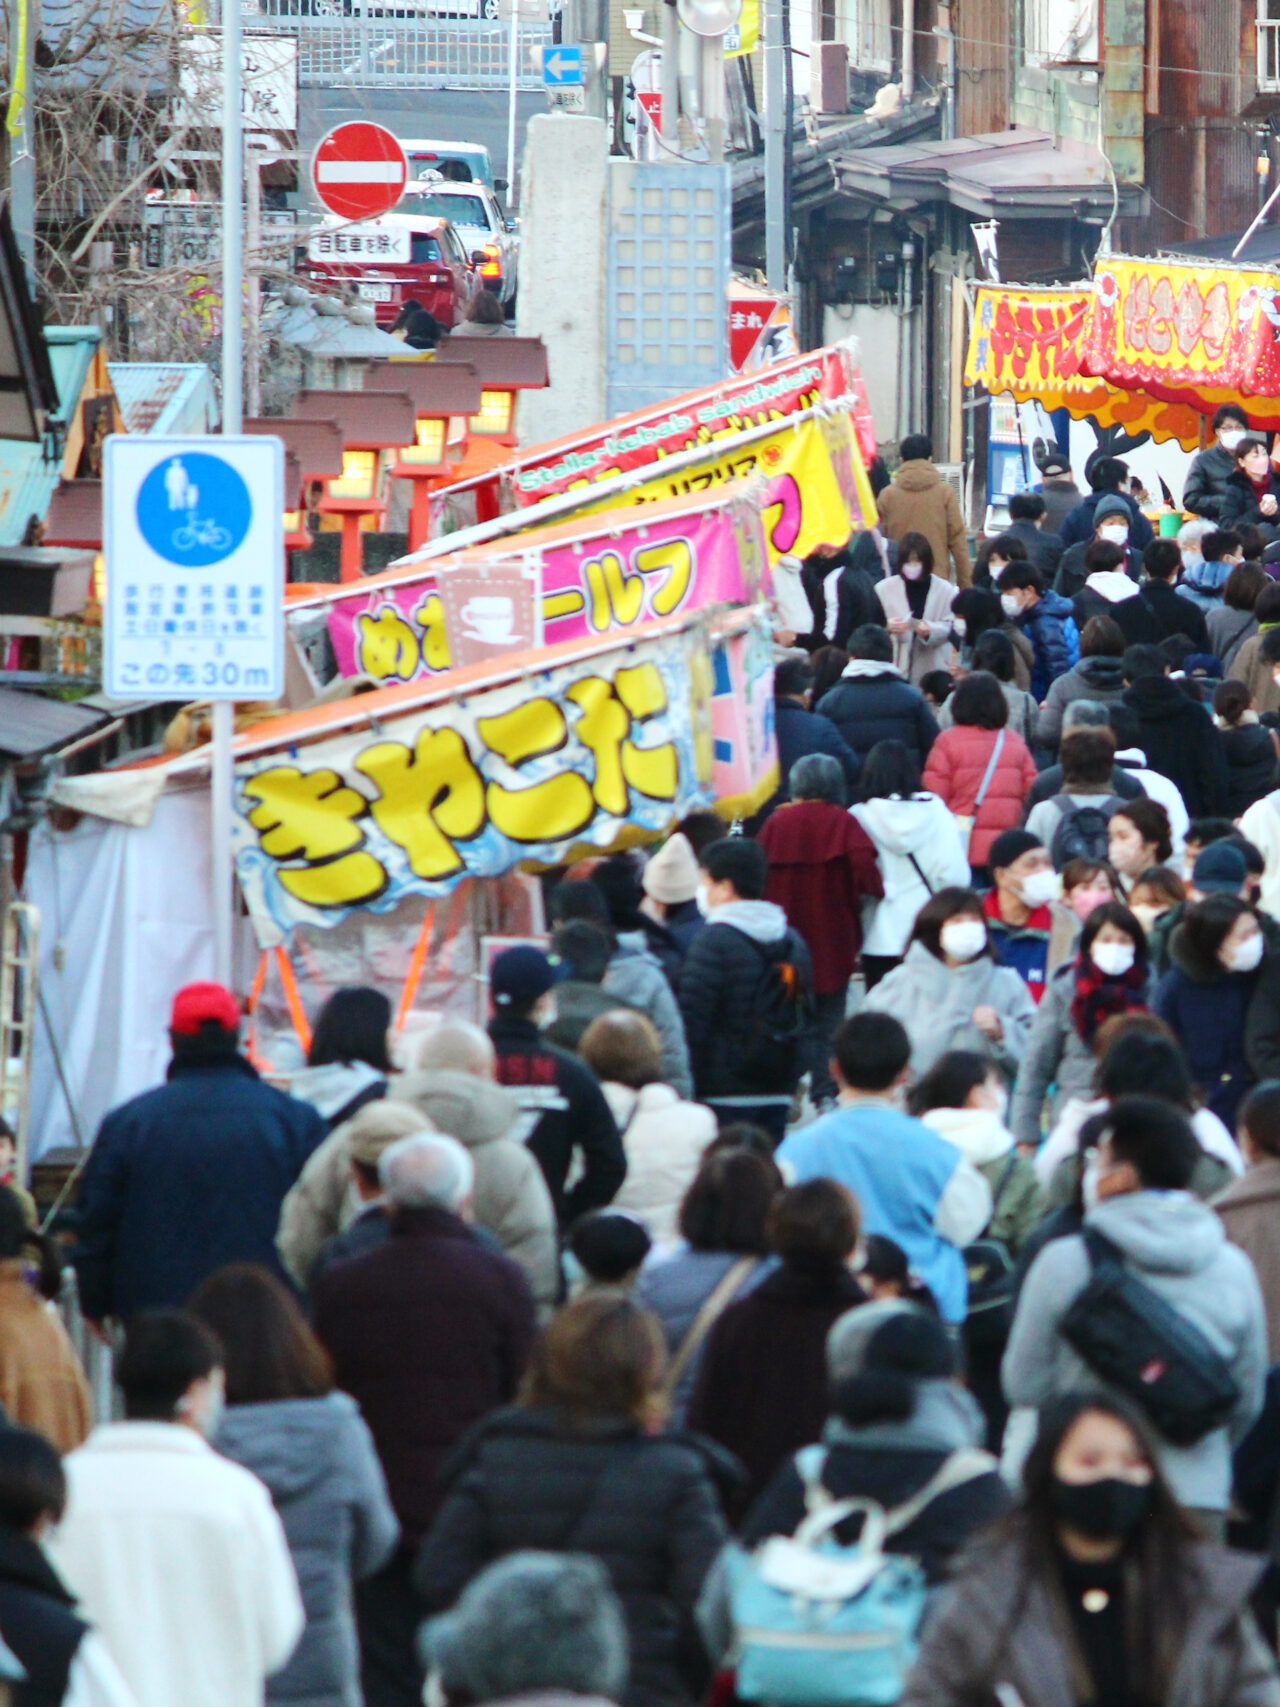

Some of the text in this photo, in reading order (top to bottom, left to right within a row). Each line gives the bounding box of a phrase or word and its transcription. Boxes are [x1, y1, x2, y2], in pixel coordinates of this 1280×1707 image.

[319, 233, 401, 254] 自転車を除く
[696, 365, 823, 424] sandwich
